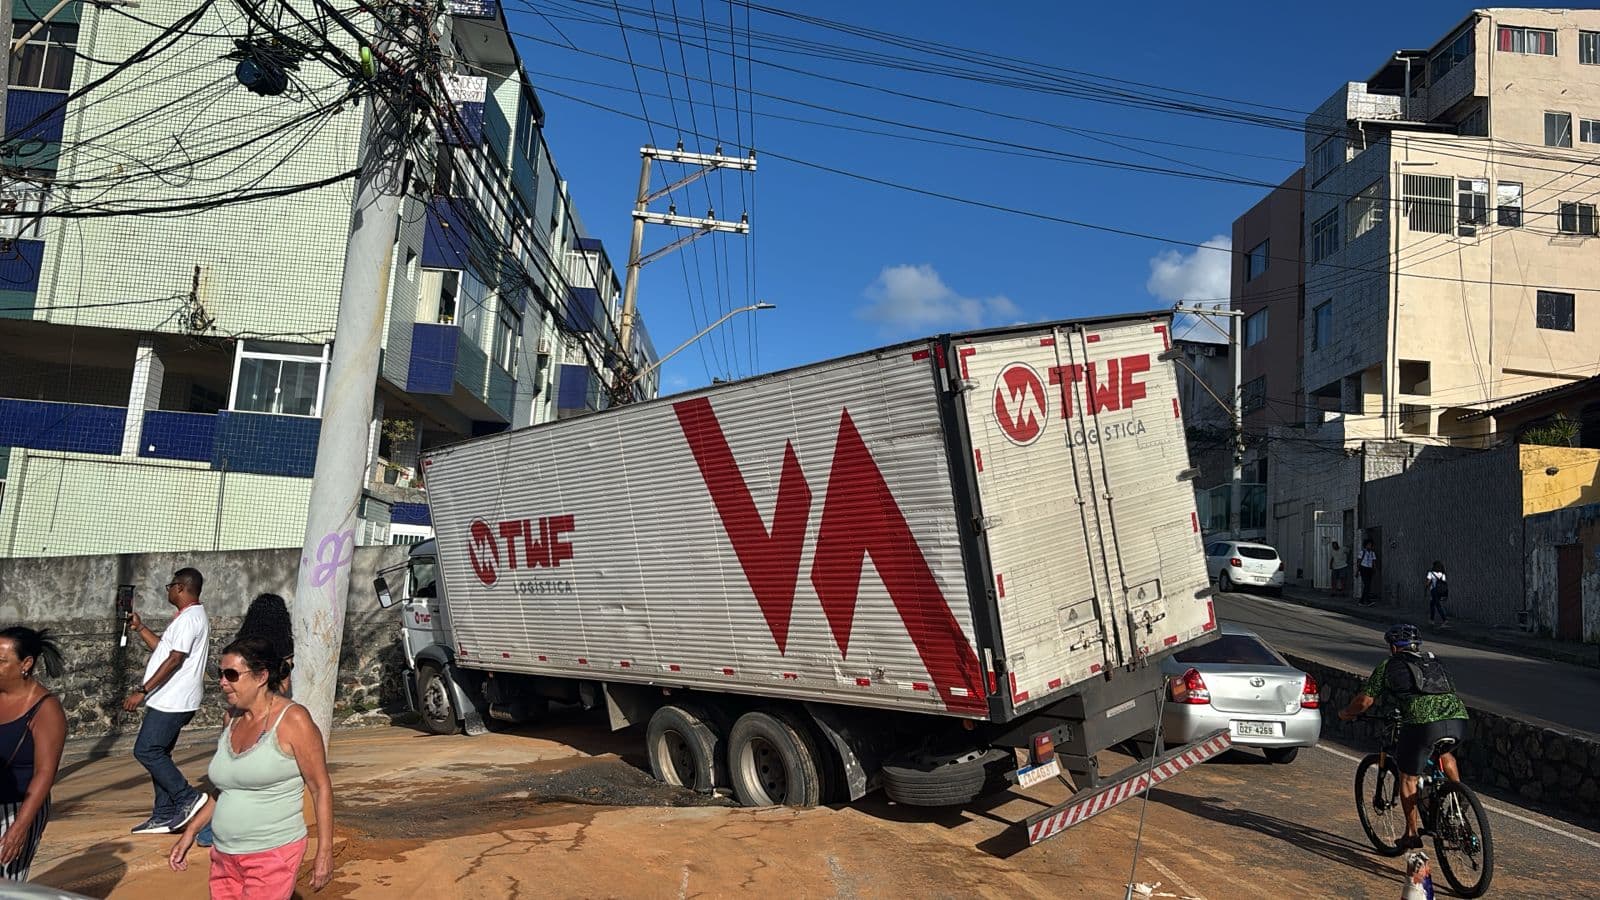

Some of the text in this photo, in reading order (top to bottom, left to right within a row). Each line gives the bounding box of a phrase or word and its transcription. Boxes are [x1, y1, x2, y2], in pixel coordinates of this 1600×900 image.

[1048, 354, 1150, 419] TWF
[1065, 419, 1146, 448] LOGSTICA
[499, 514, 575, 569] TWF
